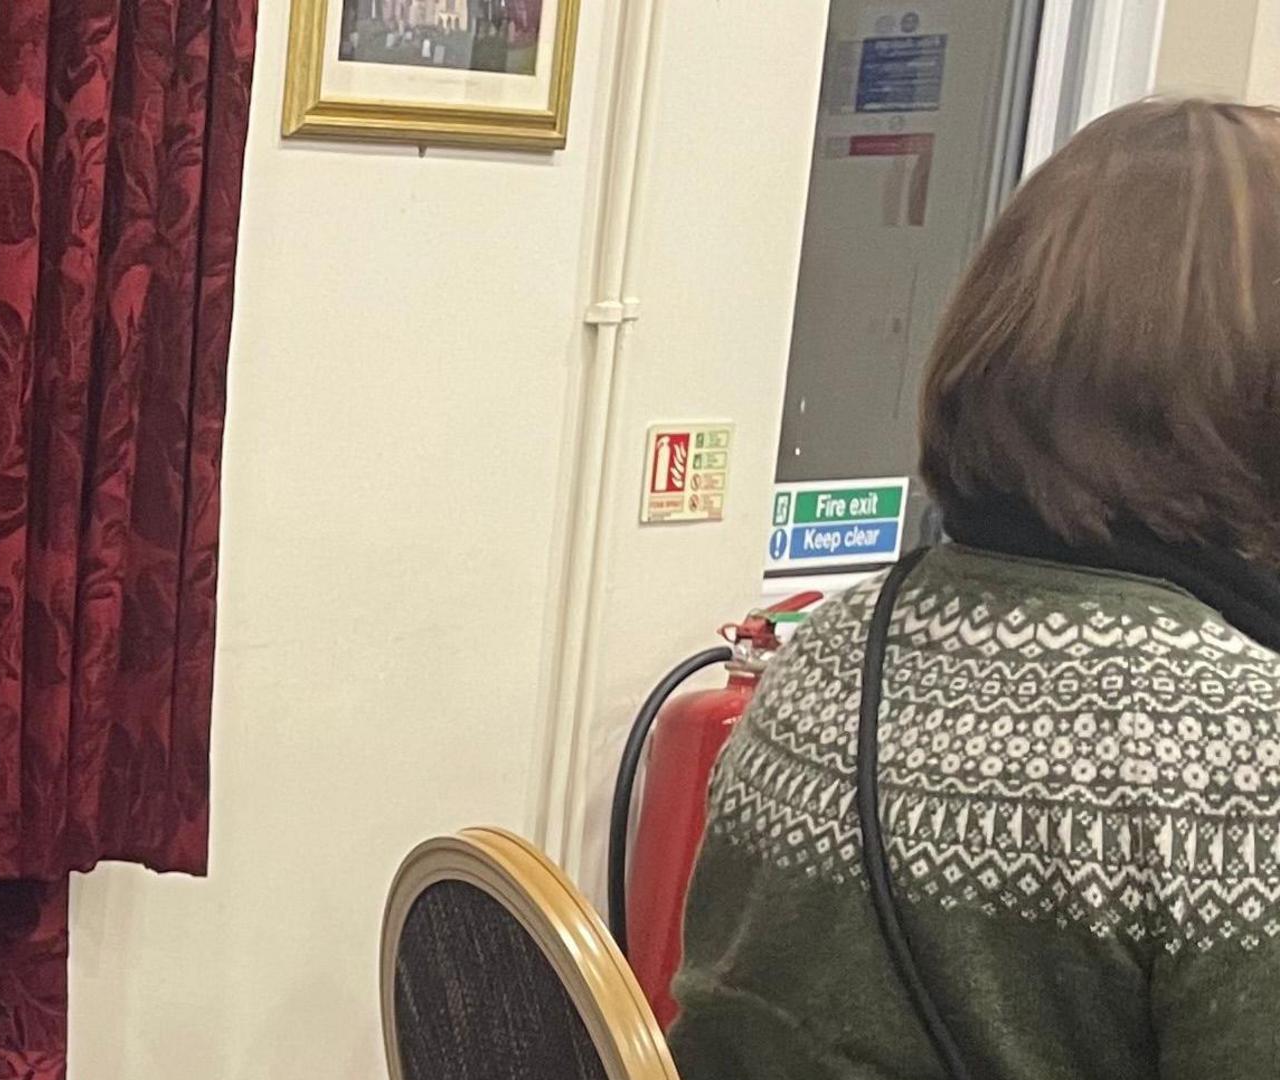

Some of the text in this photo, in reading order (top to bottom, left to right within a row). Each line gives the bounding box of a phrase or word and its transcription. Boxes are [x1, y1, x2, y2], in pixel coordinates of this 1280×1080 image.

[815, 492, 878, 518] Fire exit
[803, 526, 880, 552] Keep clear
